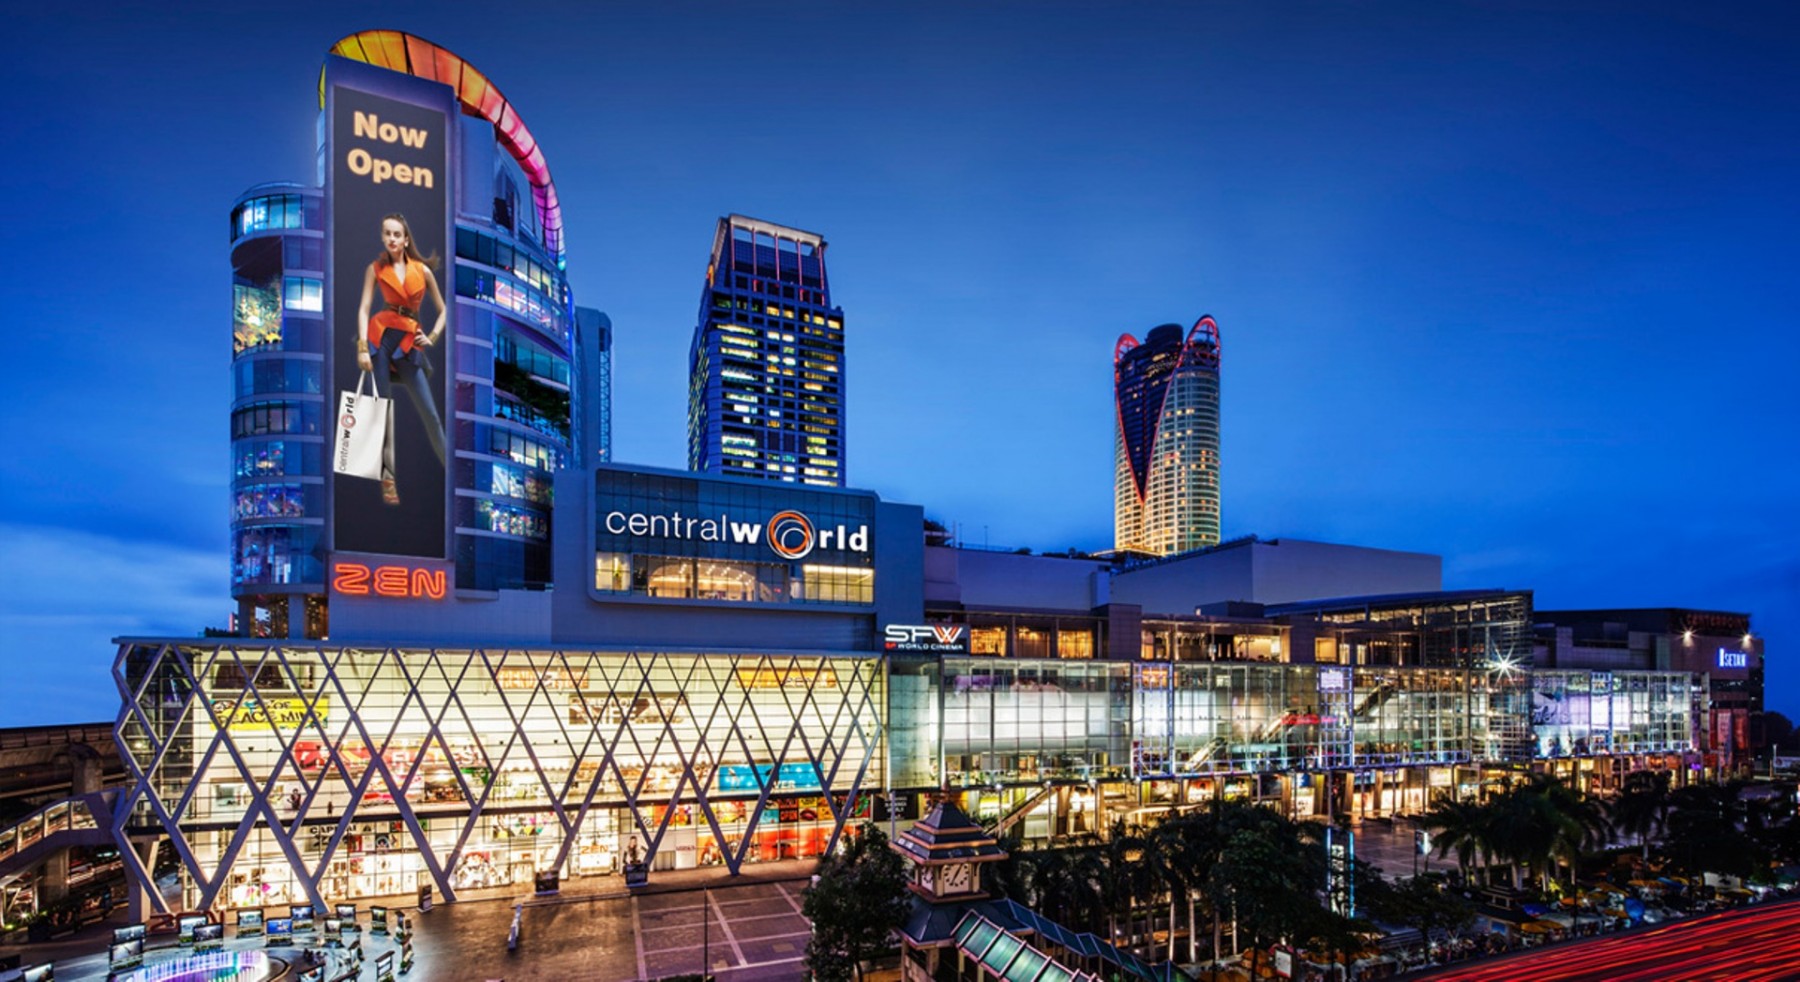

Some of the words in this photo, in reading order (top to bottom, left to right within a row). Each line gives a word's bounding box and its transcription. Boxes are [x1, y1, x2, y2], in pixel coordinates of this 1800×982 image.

[354, 110, 428, 149] Now
[347, 148, 434, 189] Open
[332, 563, 446, 599] ZEN
